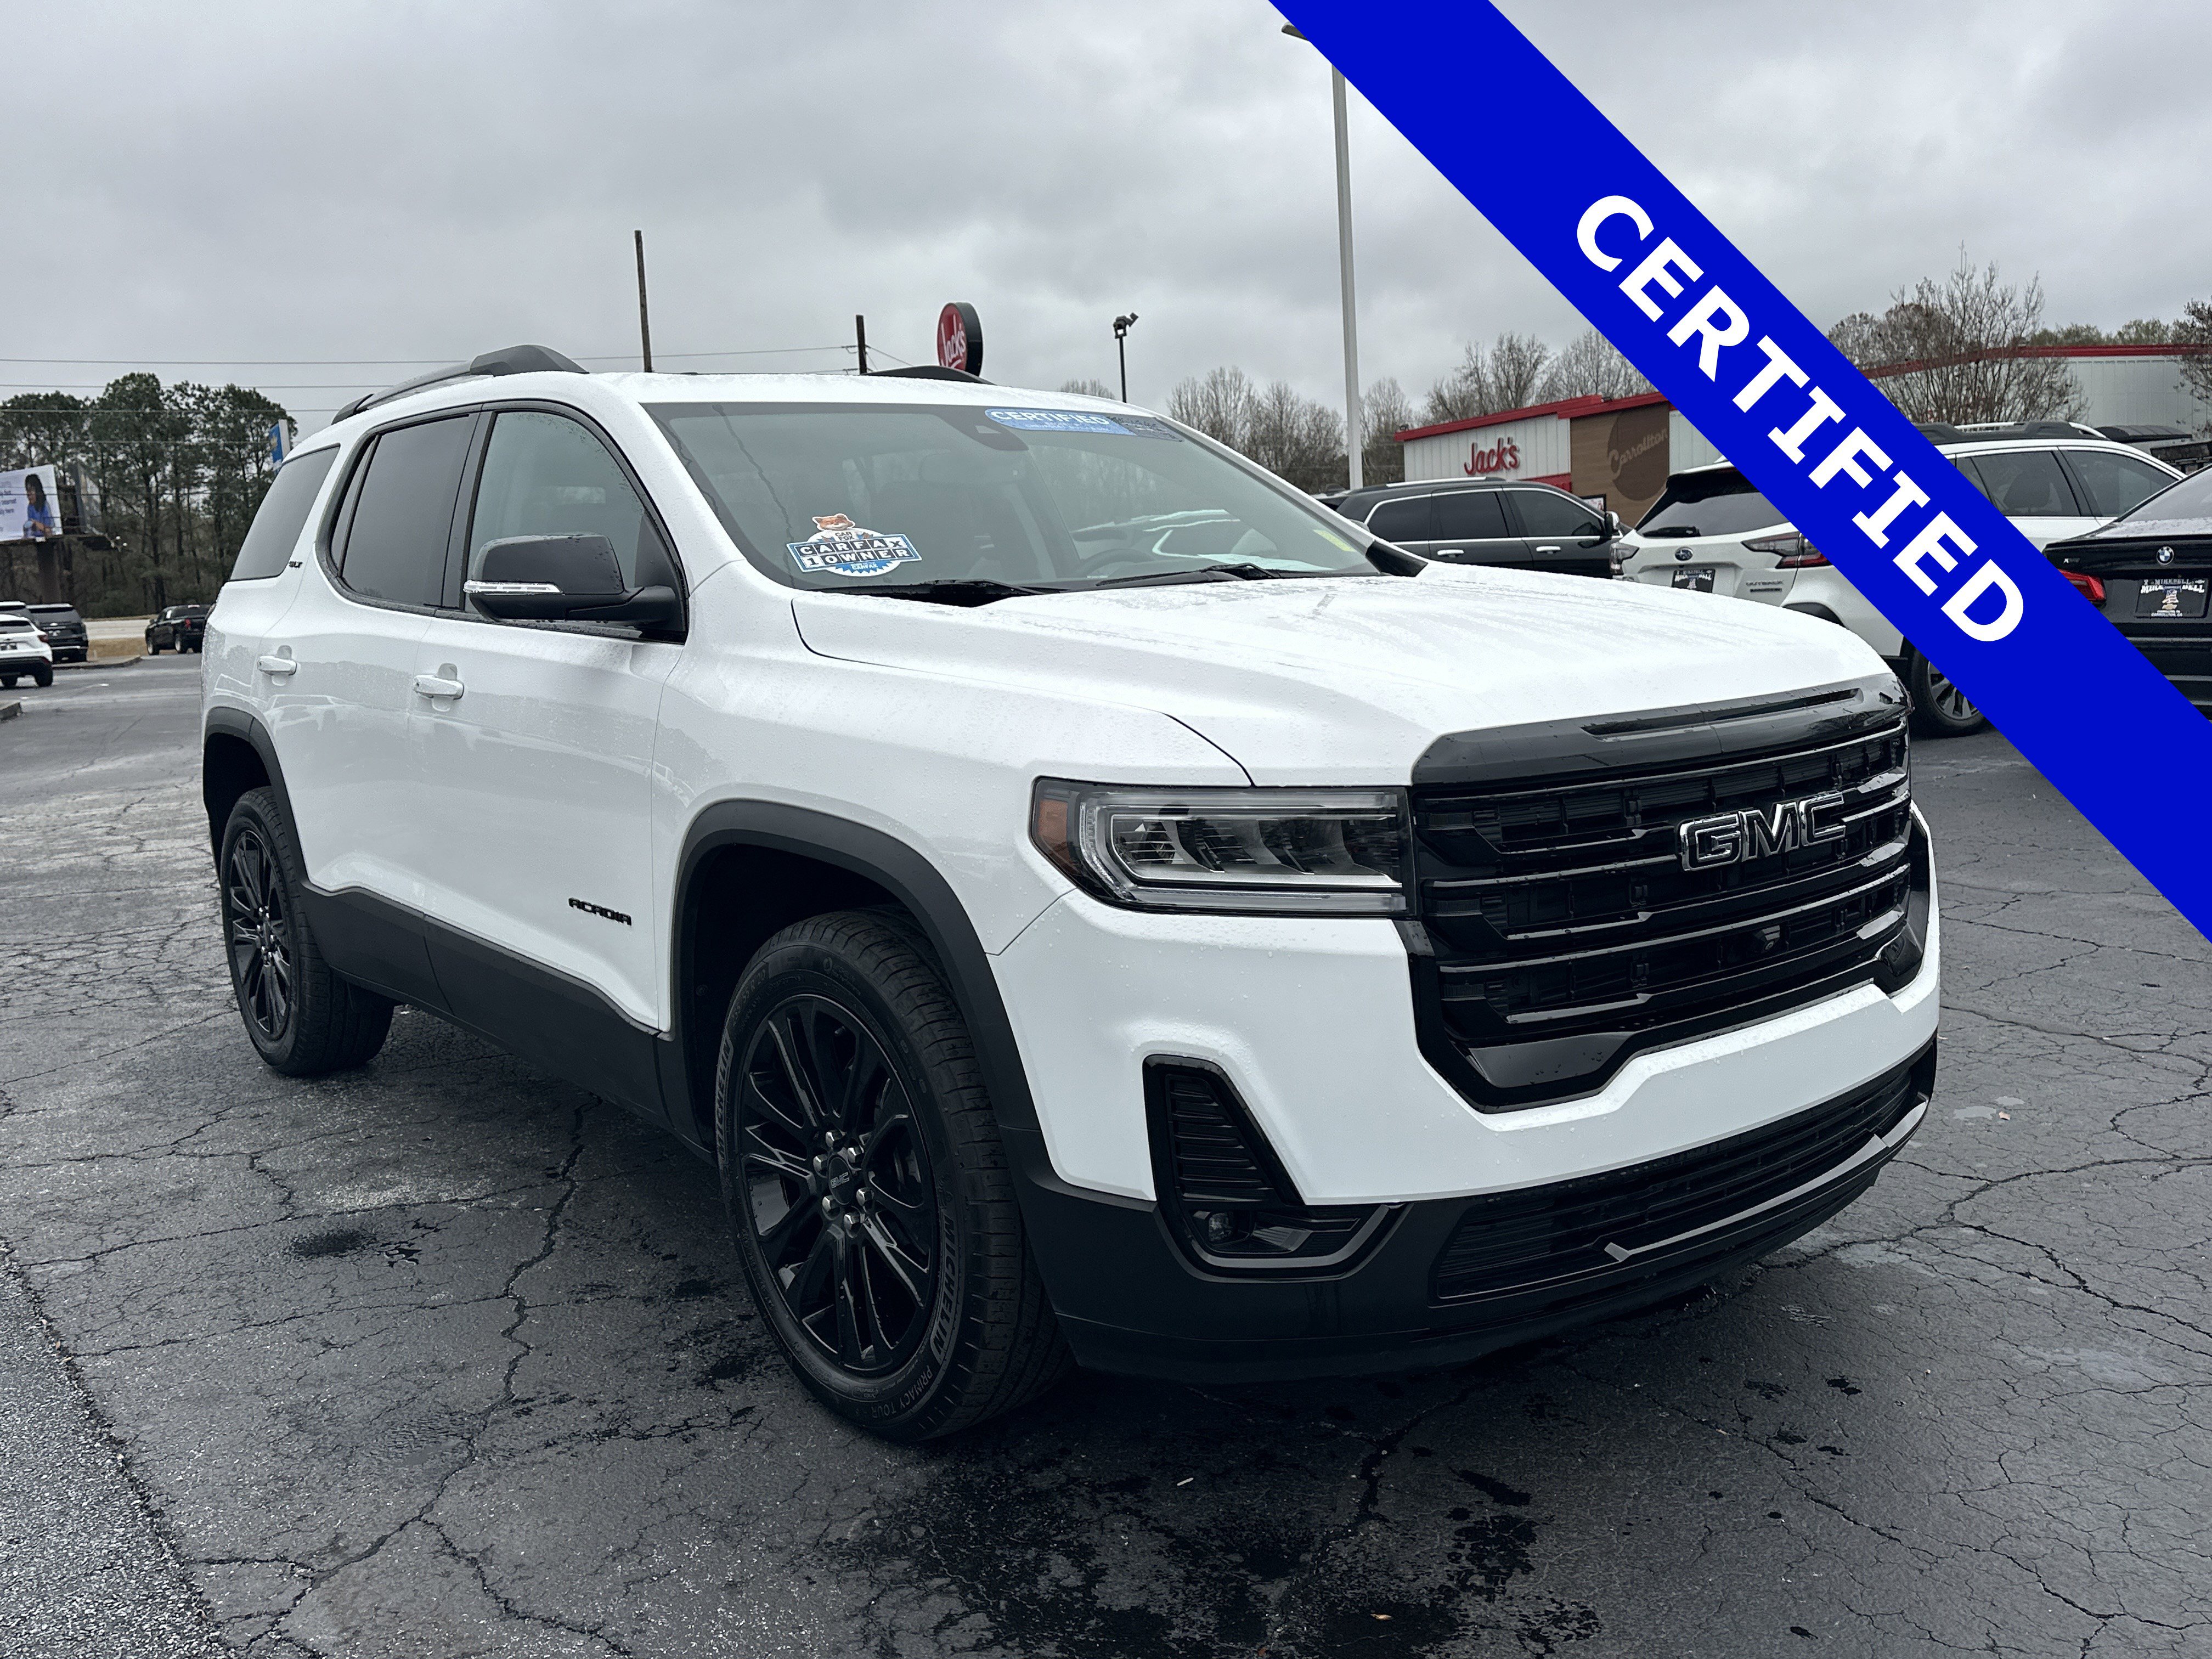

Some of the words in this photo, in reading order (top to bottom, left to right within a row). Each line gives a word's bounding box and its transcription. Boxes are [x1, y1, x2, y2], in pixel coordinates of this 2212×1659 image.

[990, 410, 1110, 425] CERTIFIED
[1464, 437, 1518, 476] Jack's
[1607, 428, 1668, 479] Carrollton
[799, 539, 904, 555] CARFAX
[806, 557, 820, 566] 1
[825, 549, 910, 564] OWNER
[1679, 792, 1847, 872] GMC
[568, 897, 632, 926] ACADIA
[830, 1171, 850, 1189] GMC
[933, 1215, 955, 1356] MICHELIN
[900, 1364, 934, 1410] PRIMACY
[871, 1401, 897, 1419] TOUR
